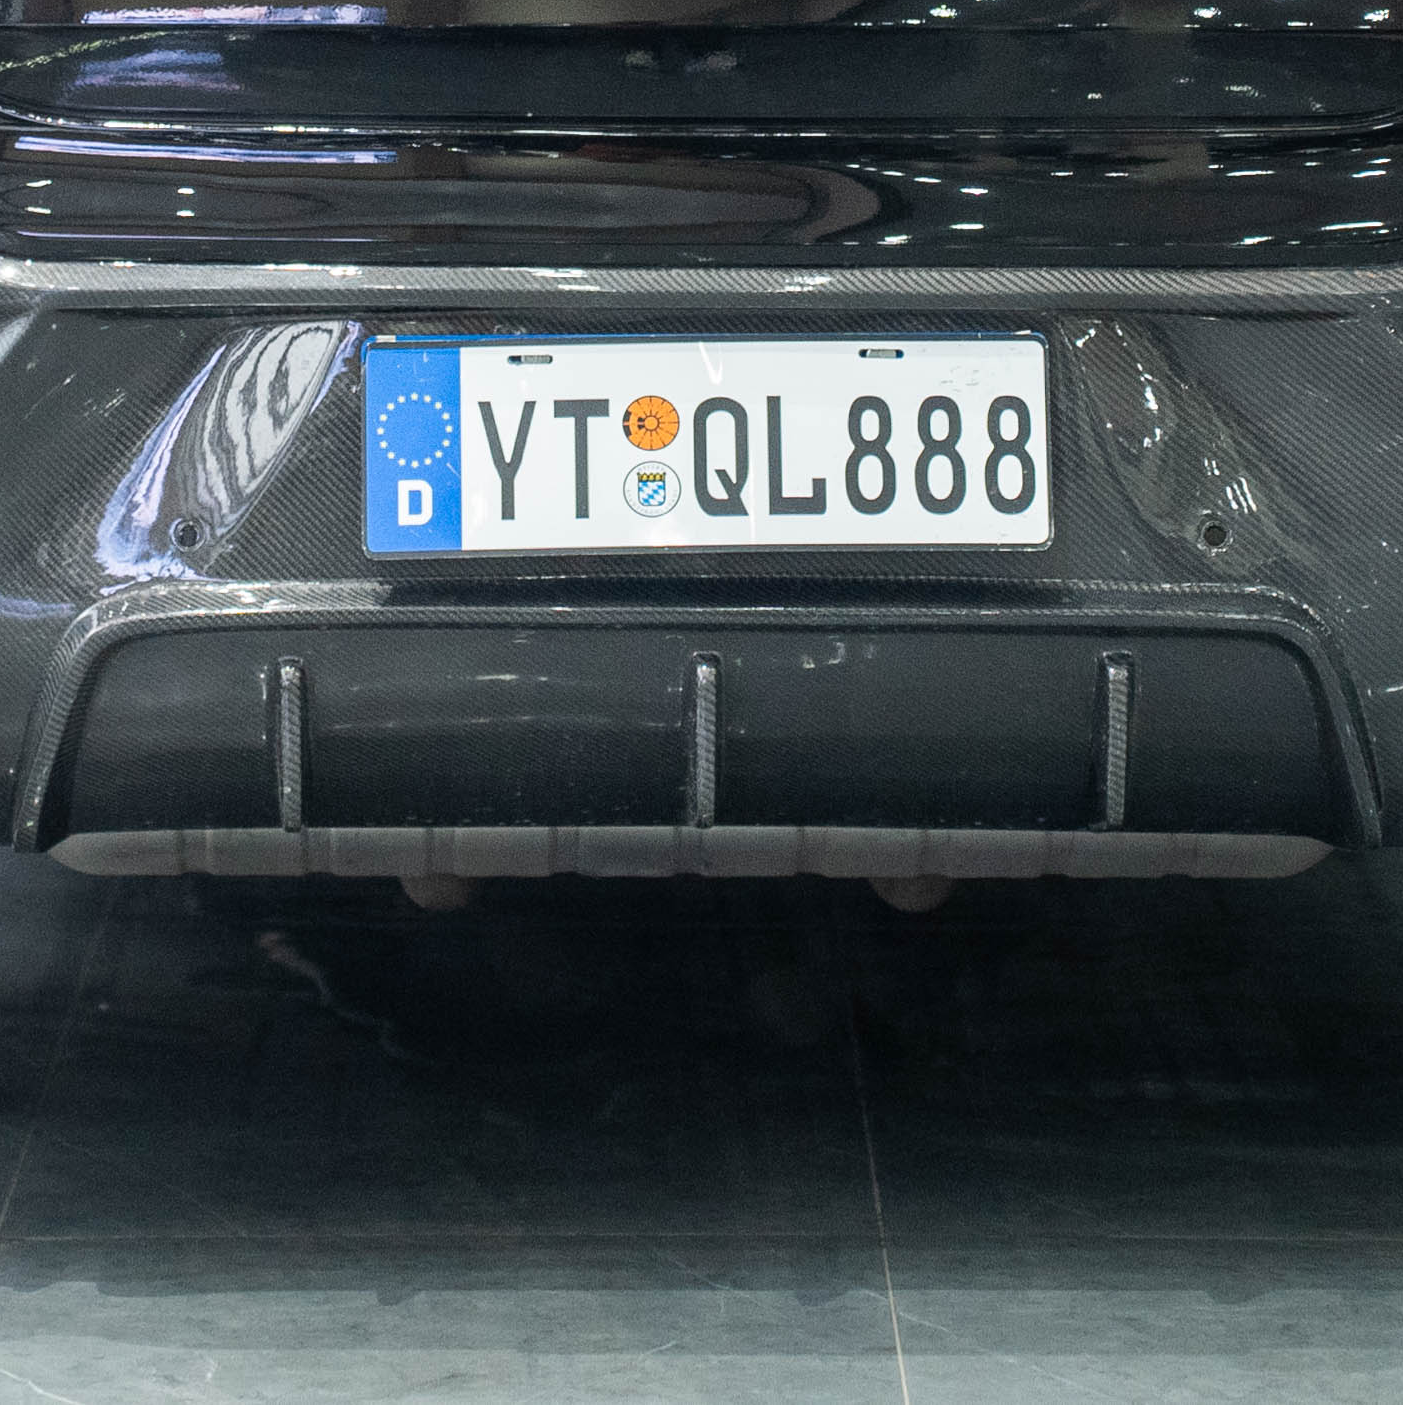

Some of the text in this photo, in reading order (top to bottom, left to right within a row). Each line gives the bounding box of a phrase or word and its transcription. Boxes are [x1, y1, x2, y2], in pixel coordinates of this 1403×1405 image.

[478, 398, 609, 520] YT
[693, 395, 1037, 516] QL888
[398, 480, 433, 526] D
